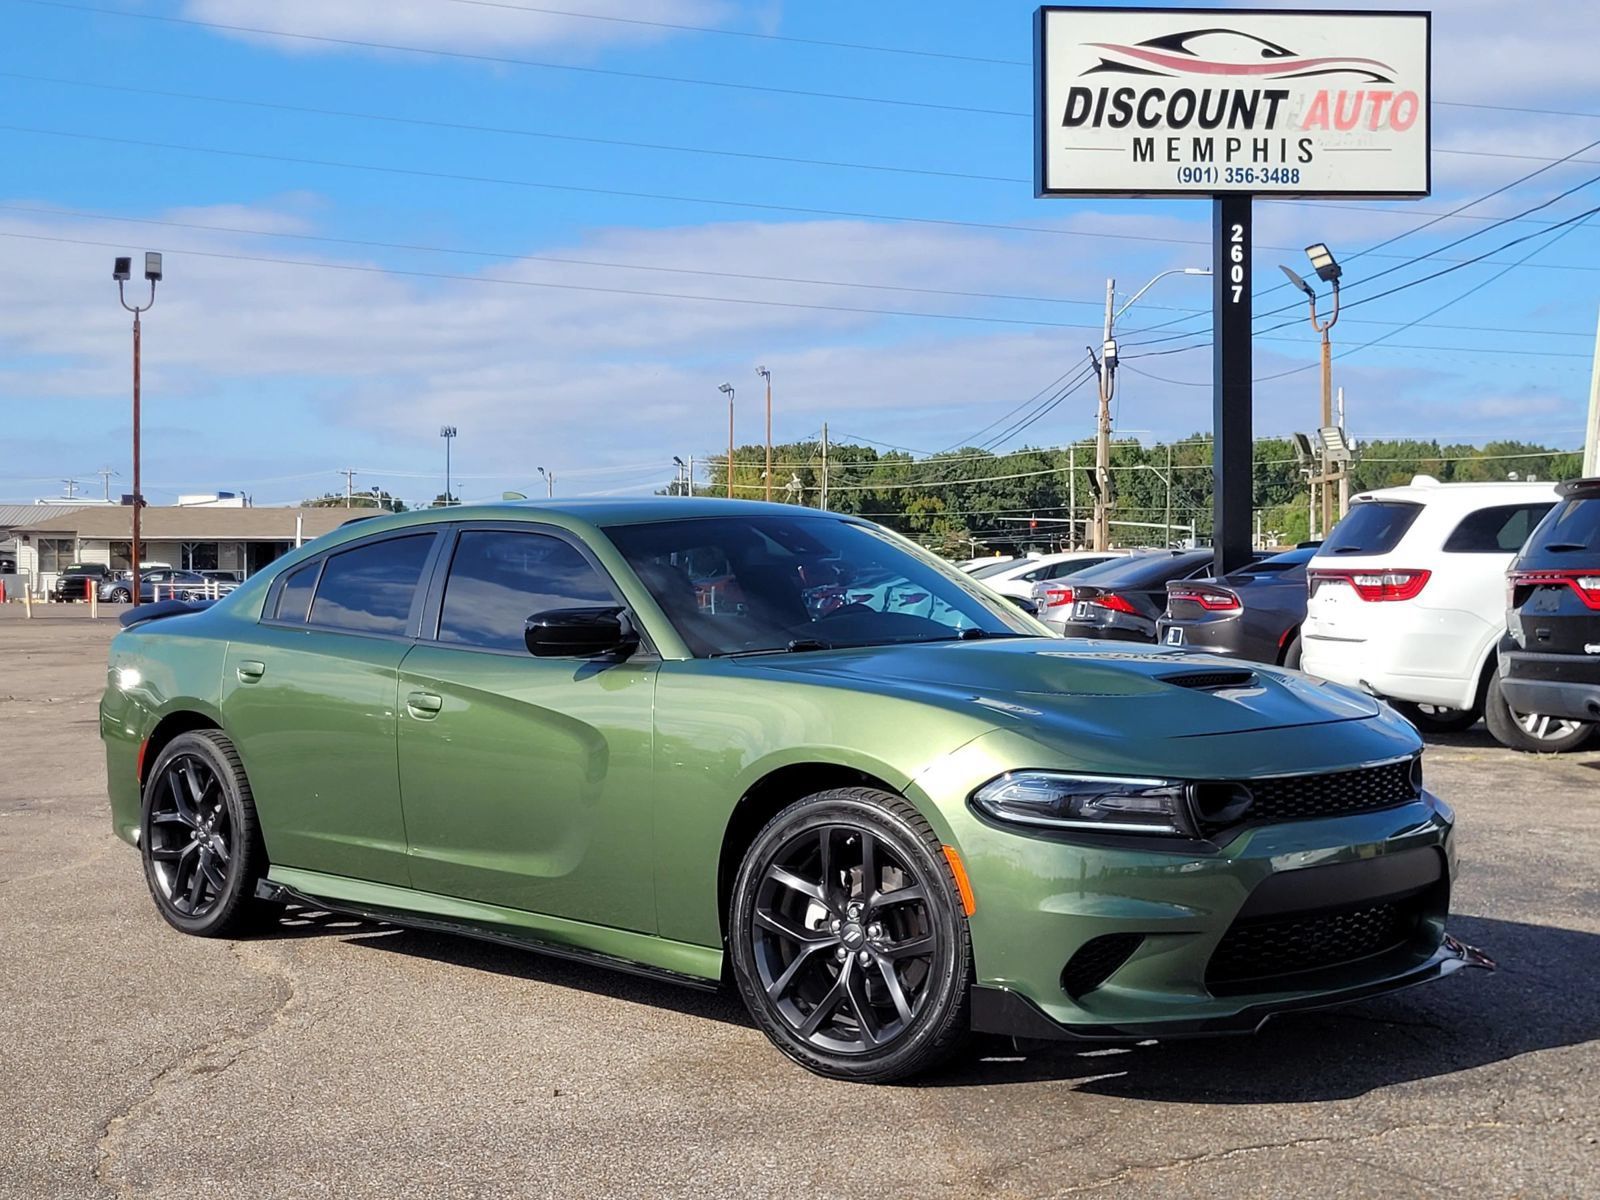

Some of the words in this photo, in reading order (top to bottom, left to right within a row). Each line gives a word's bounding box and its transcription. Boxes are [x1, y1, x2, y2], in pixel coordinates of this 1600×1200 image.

[1061, 86, 1290, 131] DISCOUNT
[1302, 90, 1419, 131] AUTO
[1132, 137, 1314, 164] MEMPHIS
[1176, 166, 1219, 184] (901)
[1224, 167, 1300, 185] 356-3488
[1230, 224, 1244, 304] 2607
